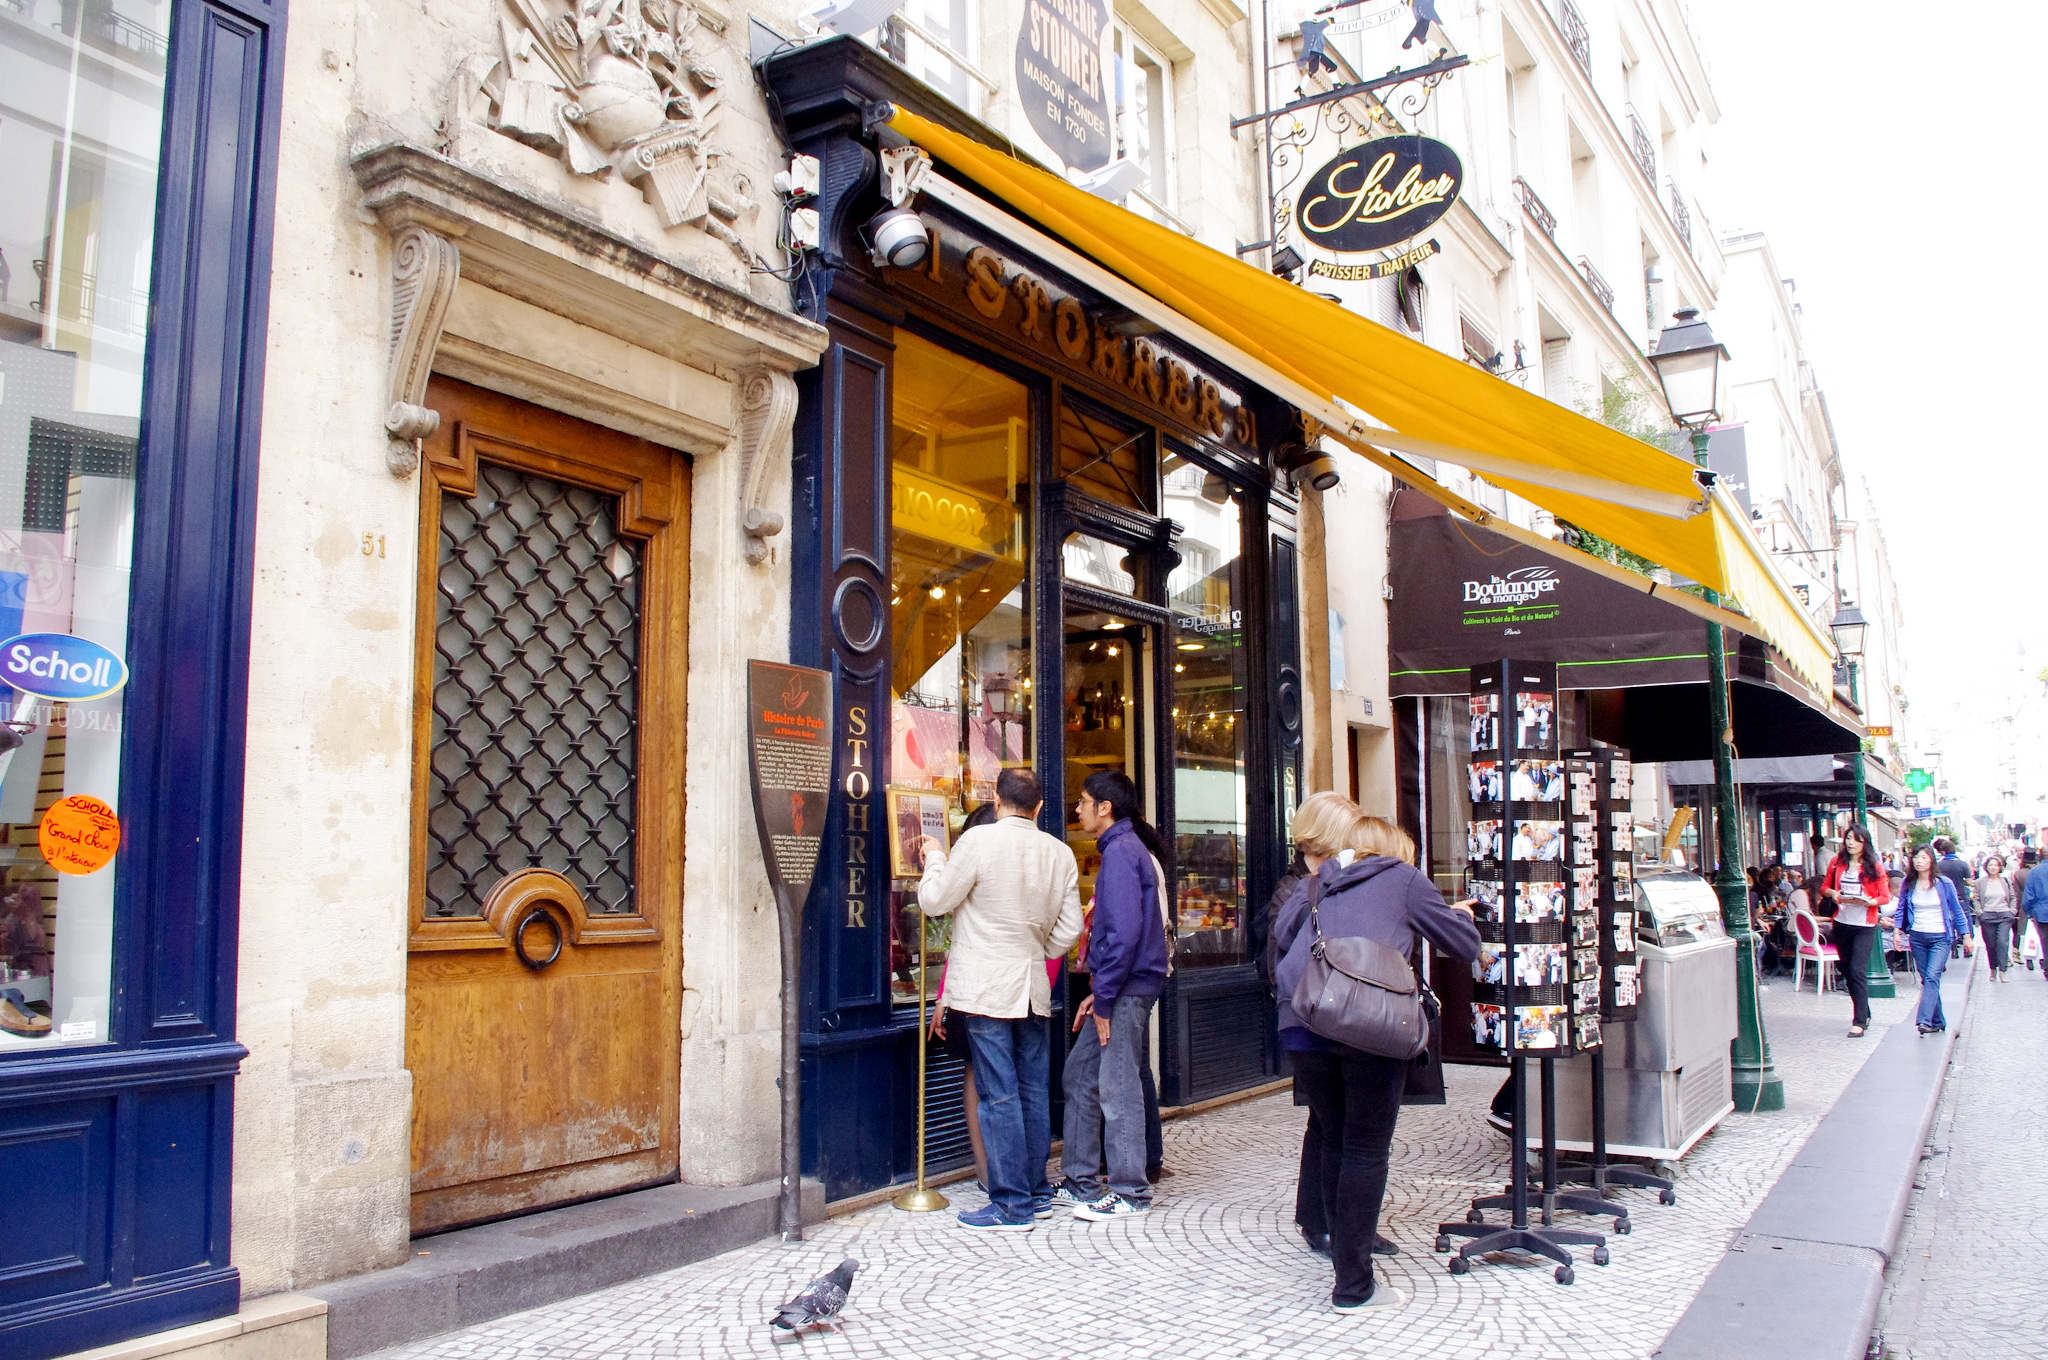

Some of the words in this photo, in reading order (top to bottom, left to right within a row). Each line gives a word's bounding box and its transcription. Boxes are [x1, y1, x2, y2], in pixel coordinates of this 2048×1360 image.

[1334, 18, 1373, 32] DEPUIS
[1378, 7, 1401, 23] 1730
[1030, 0, 1099, 103] STOHRER
[1024, 58, 1064, 103] MAISON
[1068, 94, 1105, 137] FONDEE
[1047, 100, 1061, 125] EN
[1065, 115, 1086, 143] 1730
[1303, 152, 1455, 233] Stohrer
[1312, 260, 1371, 280] PATISSIER
[1377, 242, 1434, 276] TRAITEUR
[965, 246, 1224, 438] STOHRER
[1234, 405, 1258, 450] 51
[362, 531, 386, 558] 51
[1463, 579, 1560, 601] Boulanger
[1491, 575, 1500, 584] le
[1480, 596, 1491, 605] de
[1493, 592, 1529, 606] monge
[7, 644, 111, 687] Scholl
[763, 710, 795, 724] Histoire
[796, 714, 805, 726] de
[806, 716, 825, 729] Paris
[66, 796, 115, 820] SCHOLL
[845, 707, 870, 928] STOHRER
